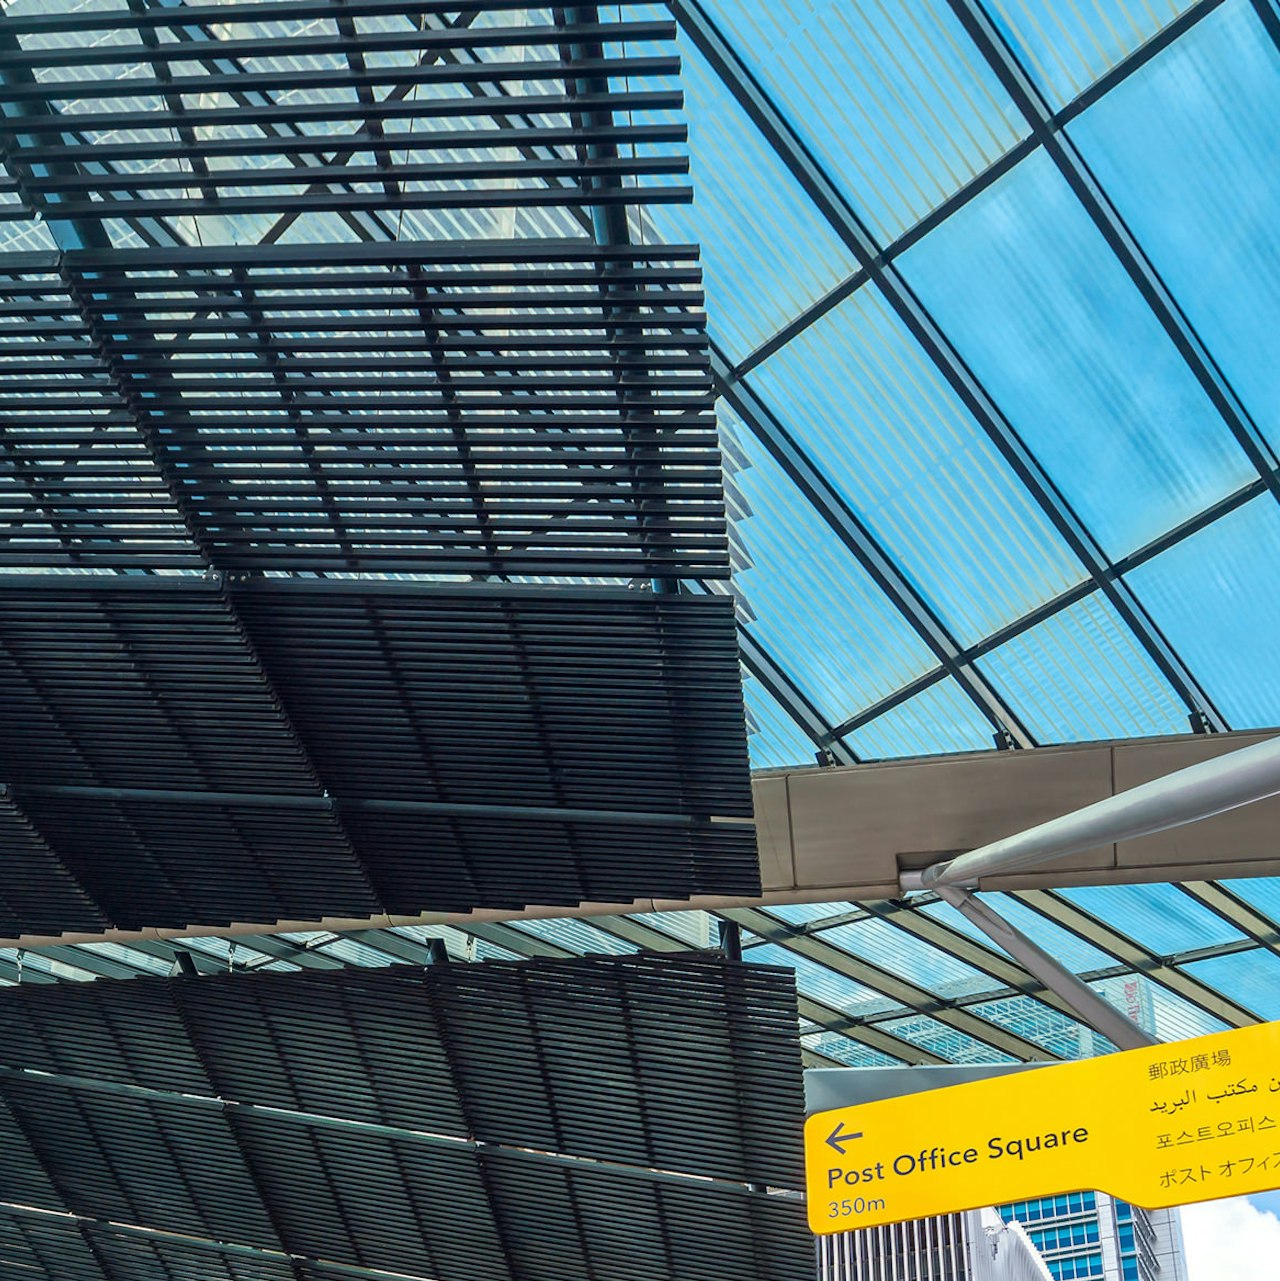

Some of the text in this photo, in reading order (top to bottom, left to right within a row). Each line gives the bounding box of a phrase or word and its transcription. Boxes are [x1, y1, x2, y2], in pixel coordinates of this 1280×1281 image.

[1148, 1050, 1232, 1080] 郵政廣場
[1149, 1089, 1196, 1116] البريد
[1206, 1078, 1258, 1100] مكتب
[1155, 1113, 1277, 1151] 포스트오피스
[827, 1123, 1089, 1188] Post Office Square
[827, 1196, 885, 1220] 350m
